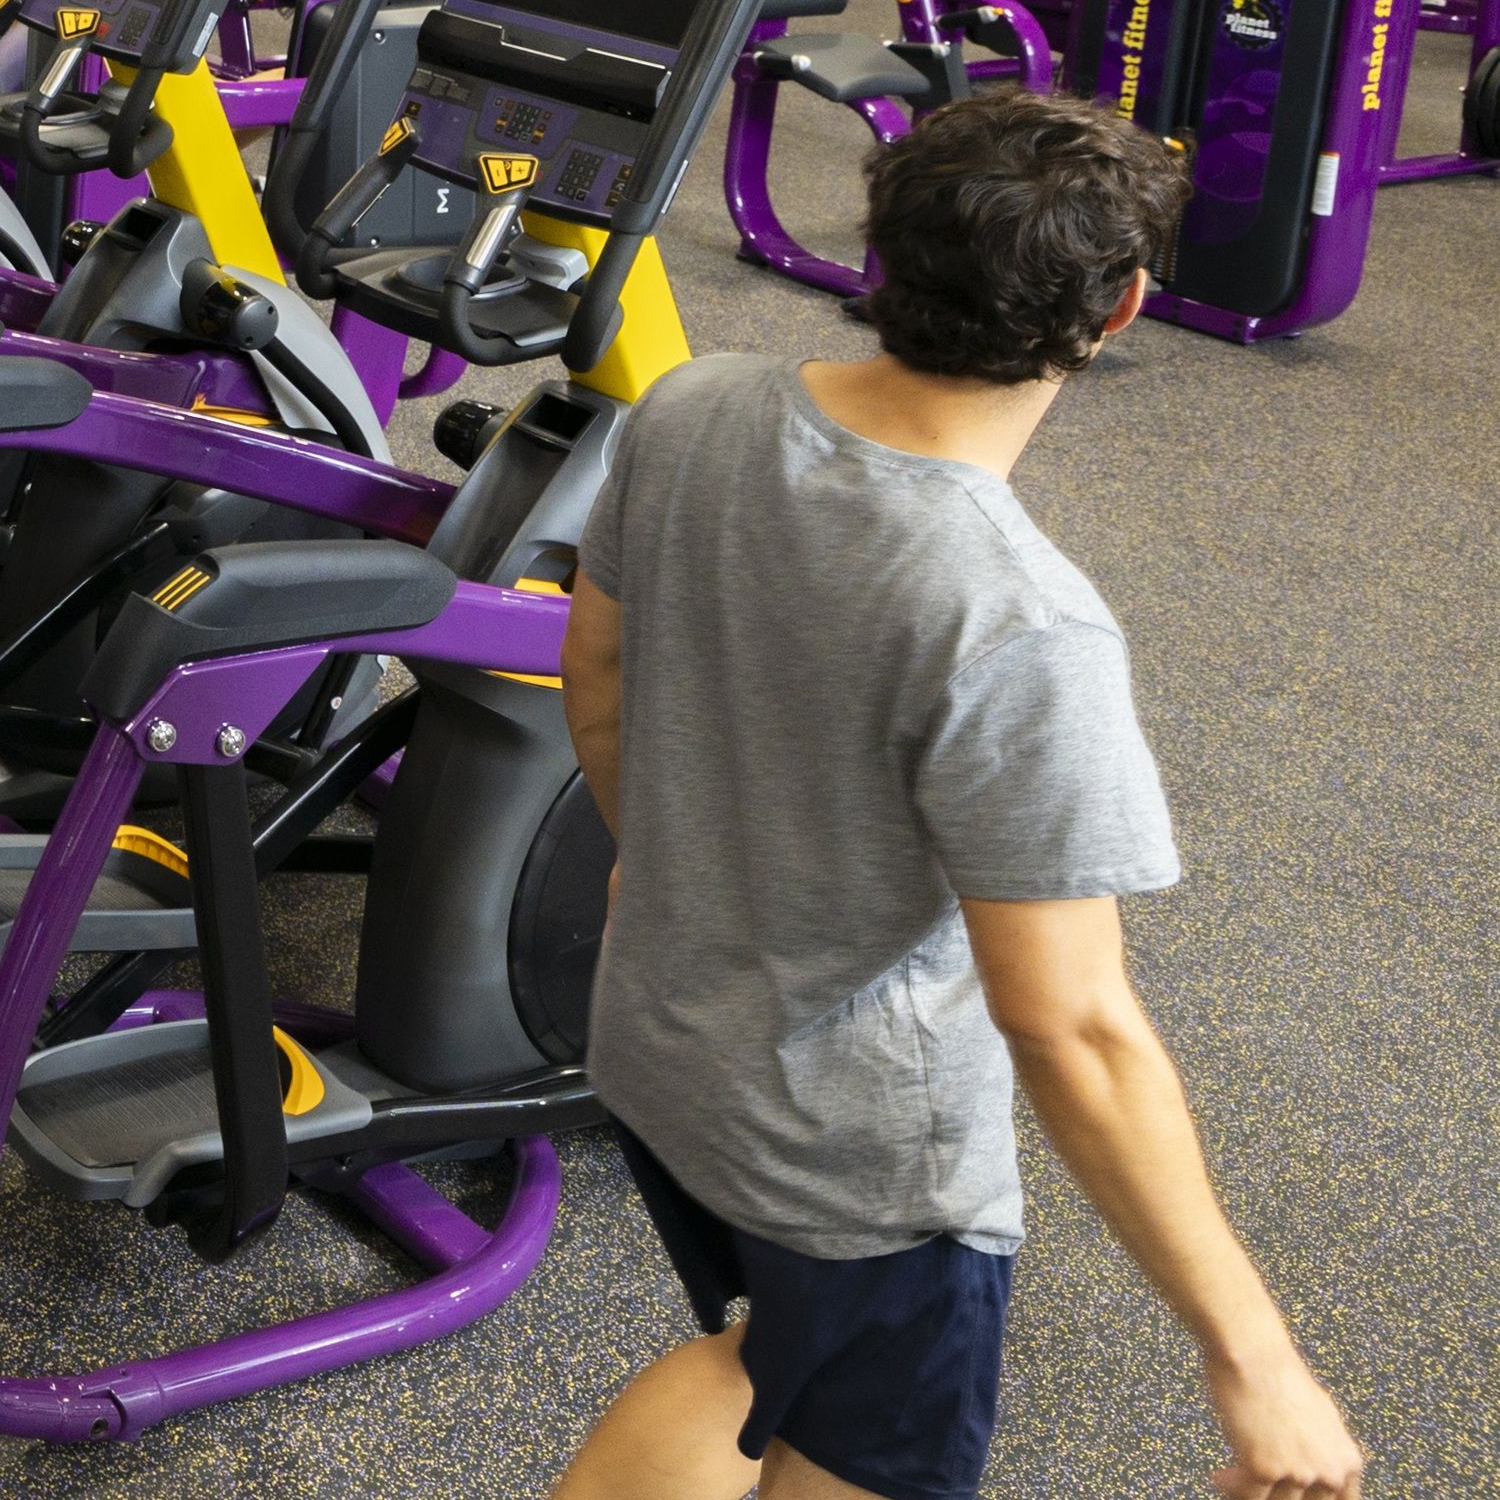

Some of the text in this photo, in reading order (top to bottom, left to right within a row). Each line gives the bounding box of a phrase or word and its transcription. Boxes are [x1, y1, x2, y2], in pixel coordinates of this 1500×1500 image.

[1225, 13, 1270, 30] planet
[1230, 25, 1278, 41] fitness
[1115, 54, 1143, 121] lanet
[1362, 23, 1389, 111] planet
